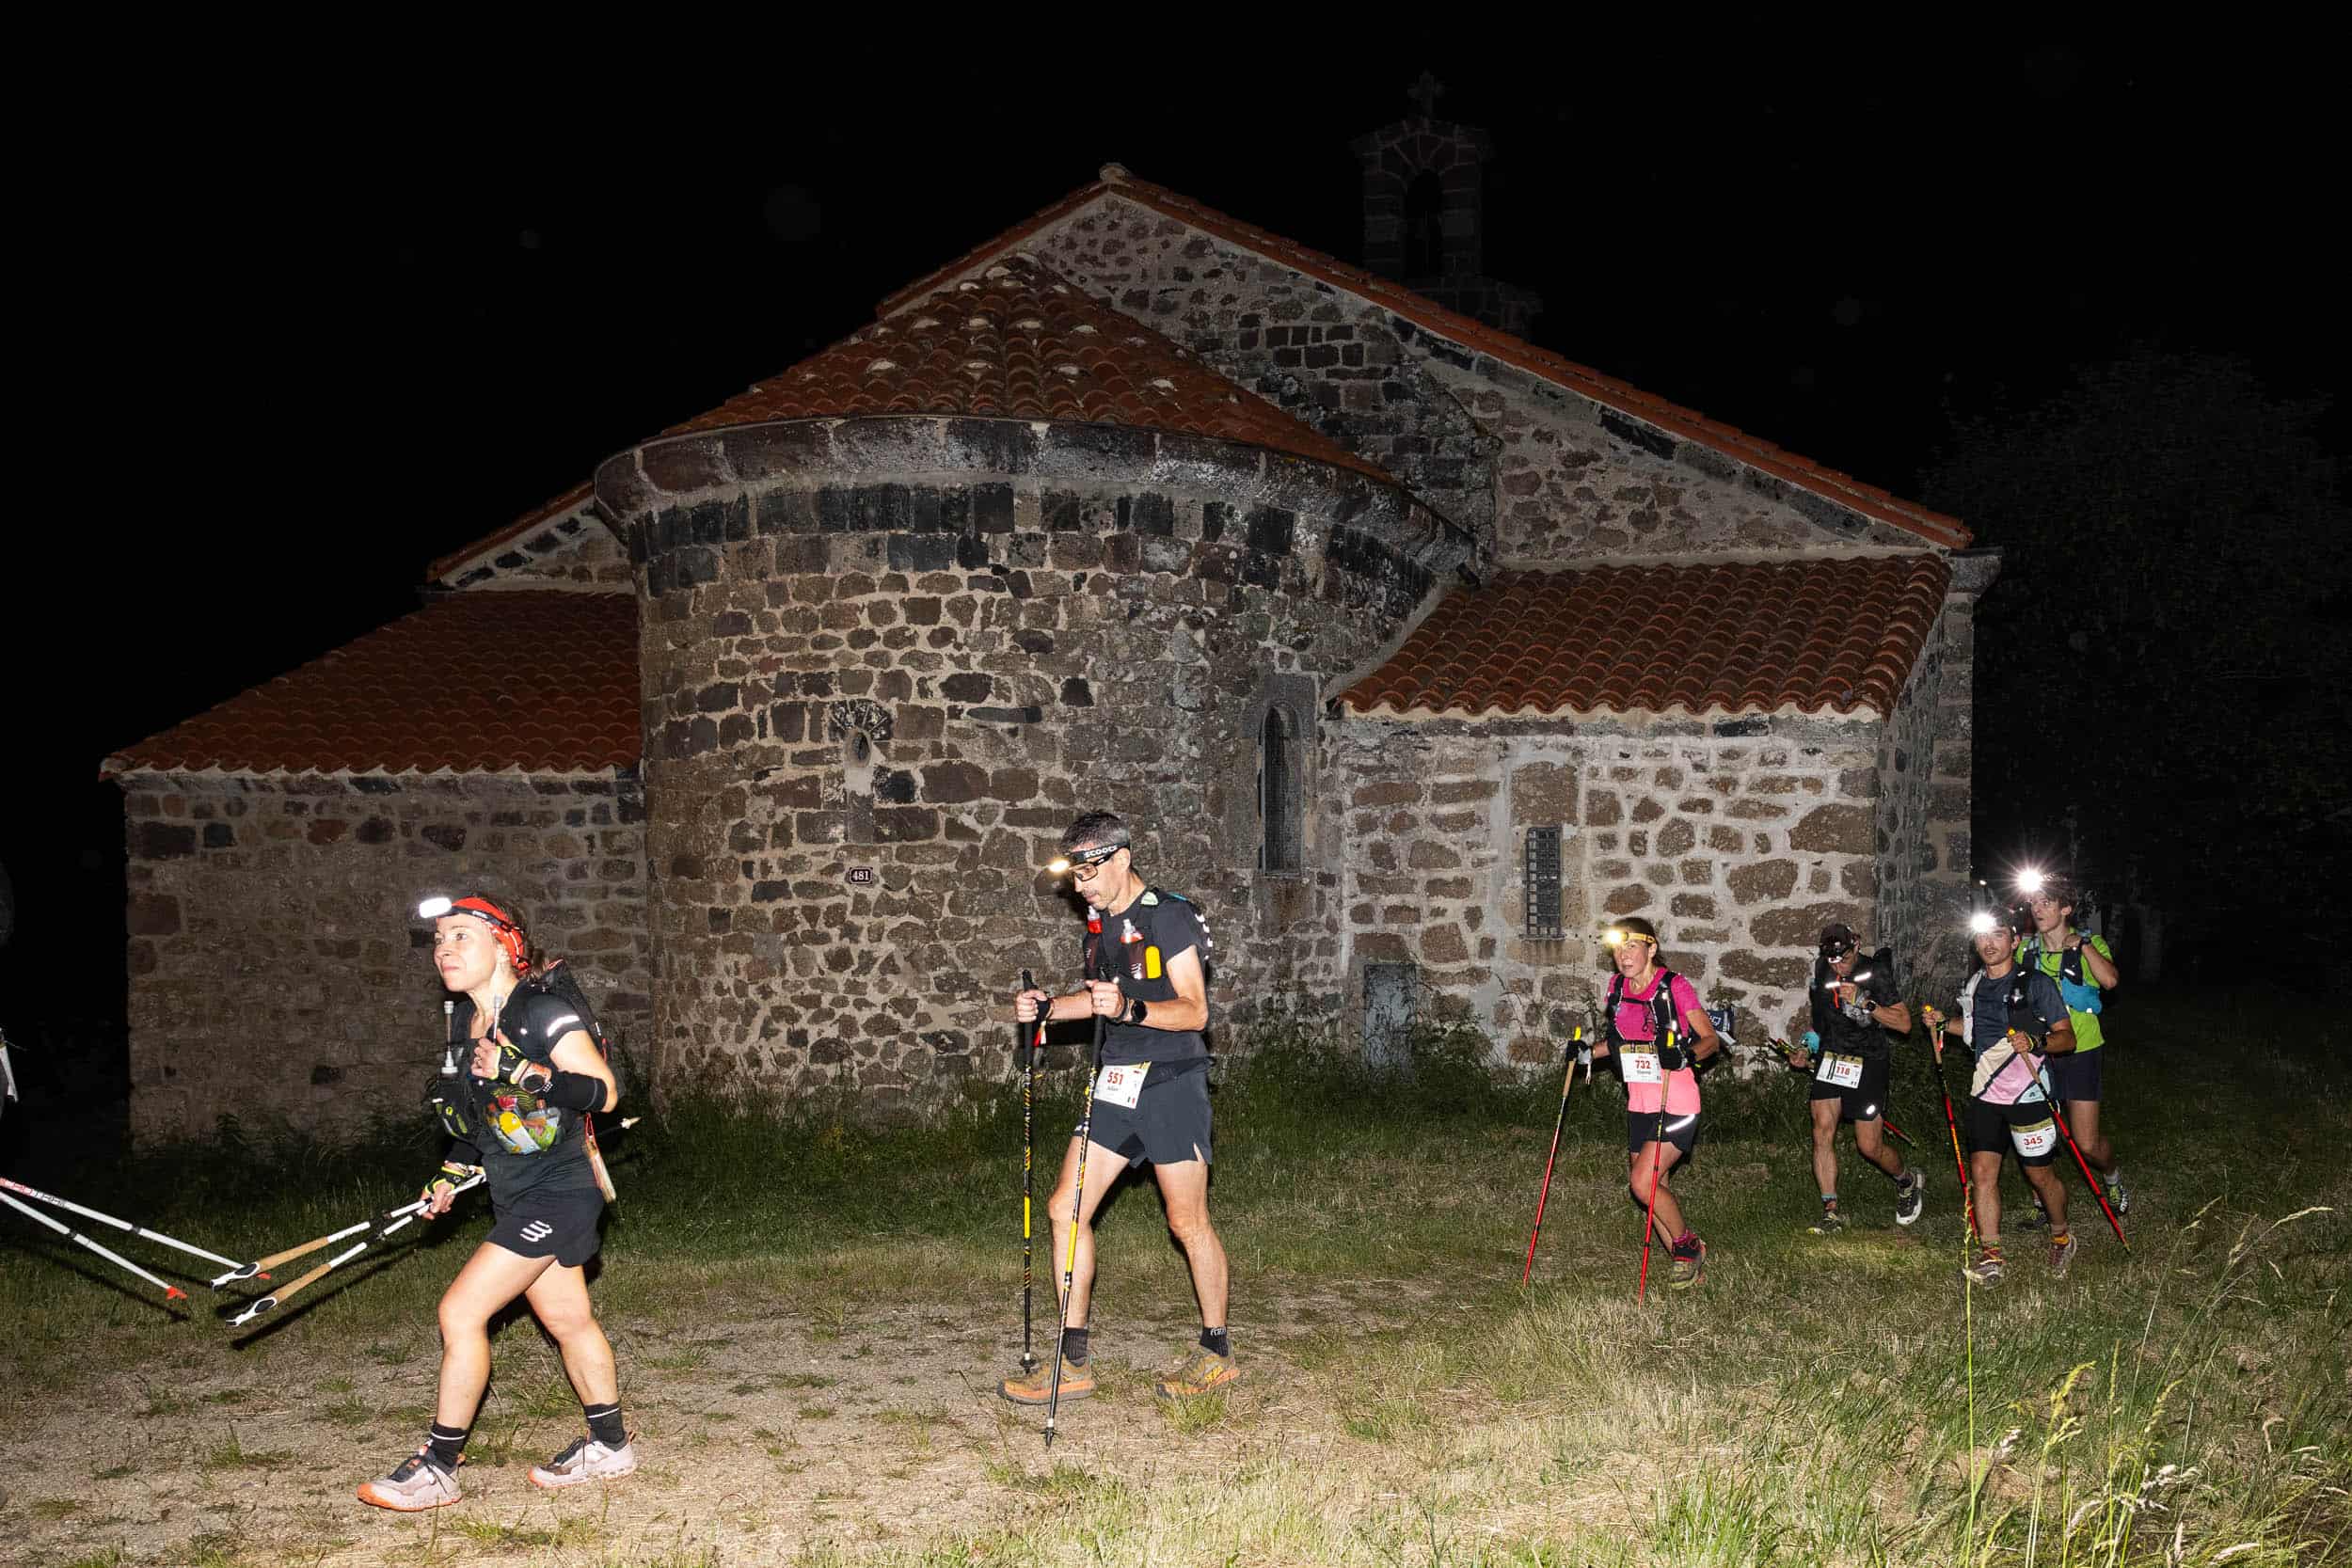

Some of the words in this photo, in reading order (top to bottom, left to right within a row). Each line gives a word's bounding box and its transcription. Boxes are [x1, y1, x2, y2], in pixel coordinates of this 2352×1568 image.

[852, 870, 869, 880] 481
[1634, 1060, 1651, 1069] 732
[1106, 1071, 1124, 1085] 551
[2023, 1135, 2043, 1146] 345
